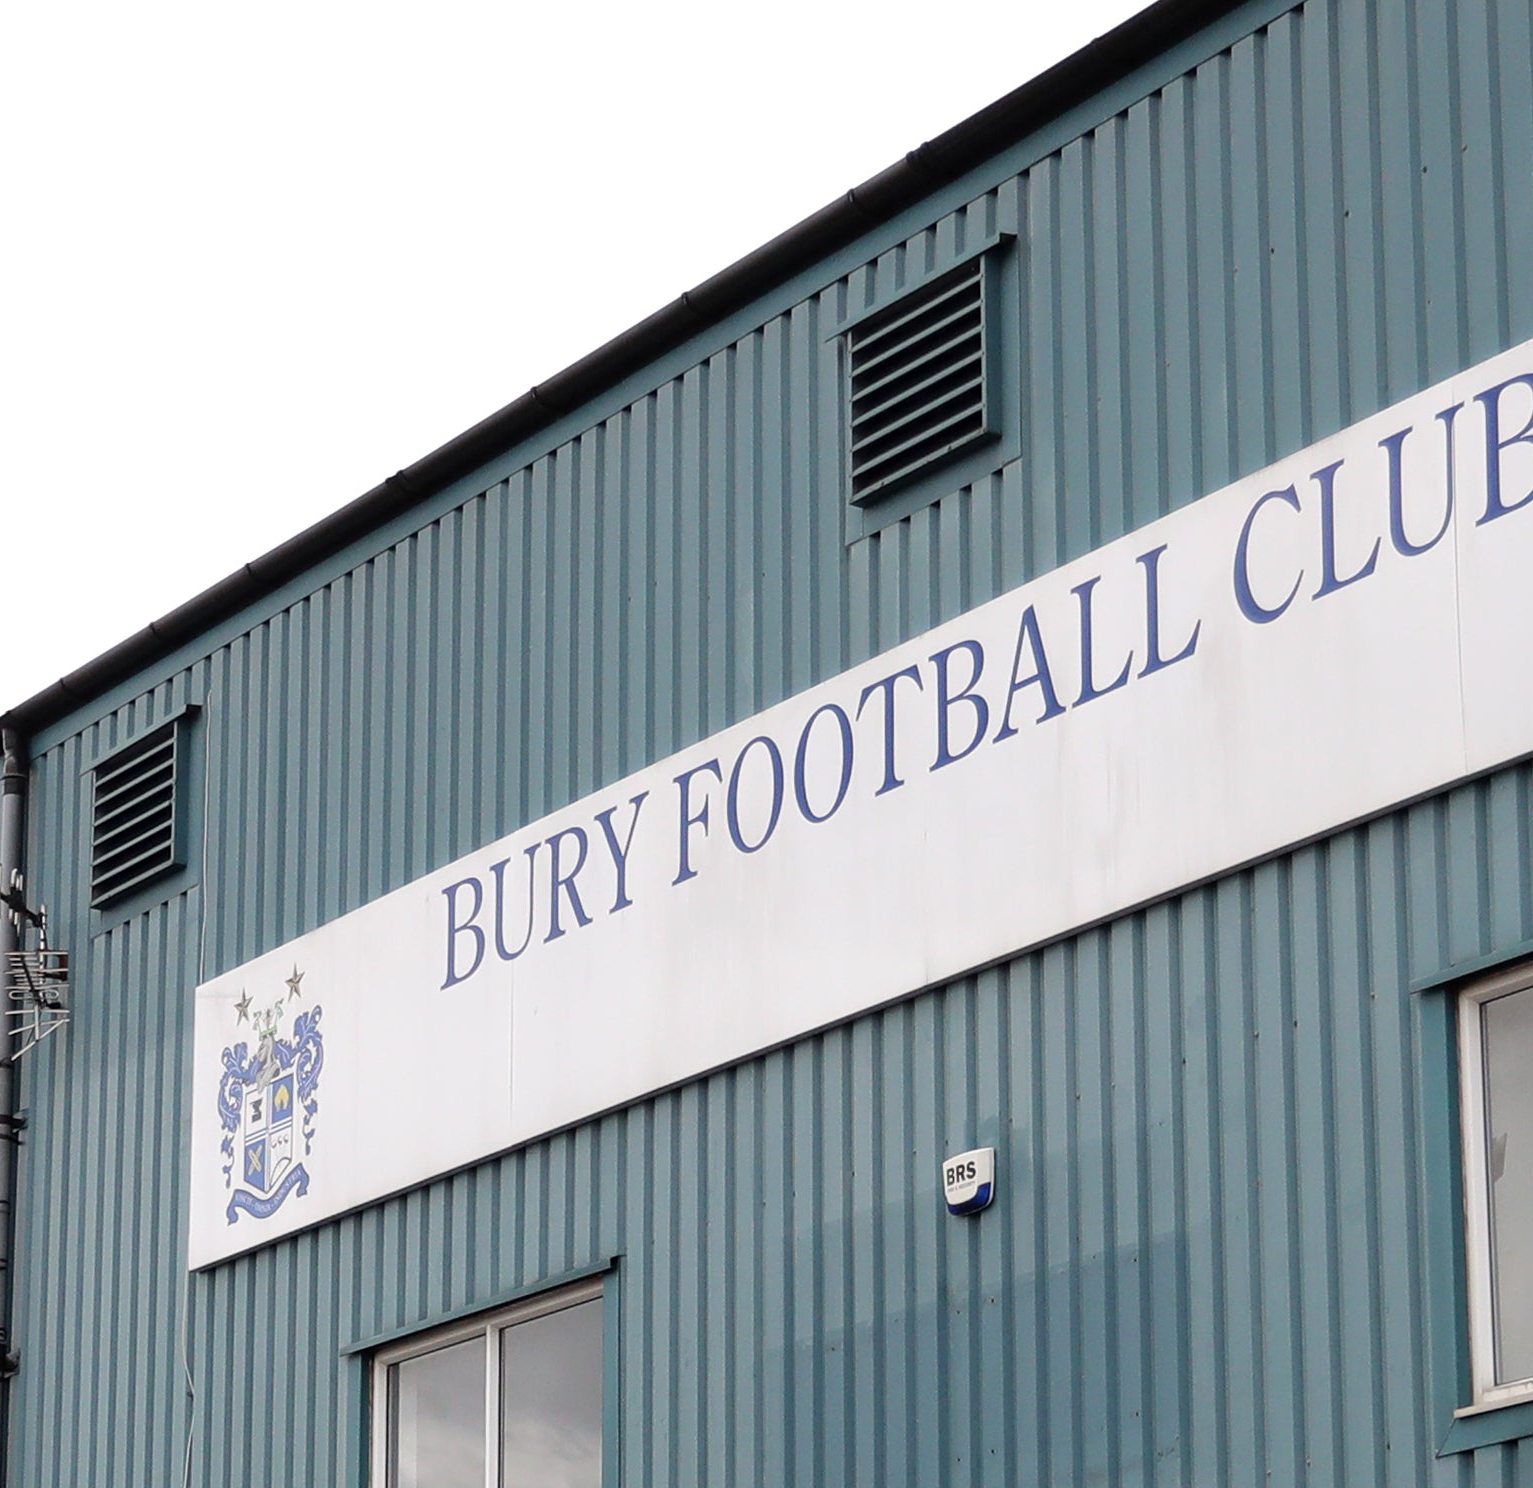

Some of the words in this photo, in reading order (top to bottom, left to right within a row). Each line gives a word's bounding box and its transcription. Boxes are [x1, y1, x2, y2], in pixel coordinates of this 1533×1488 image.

[440, 790, 648, 991] BURY
[672, 543, 1203, 888] FOOTBALL
[946, 1161, 976, 1187] BRS
